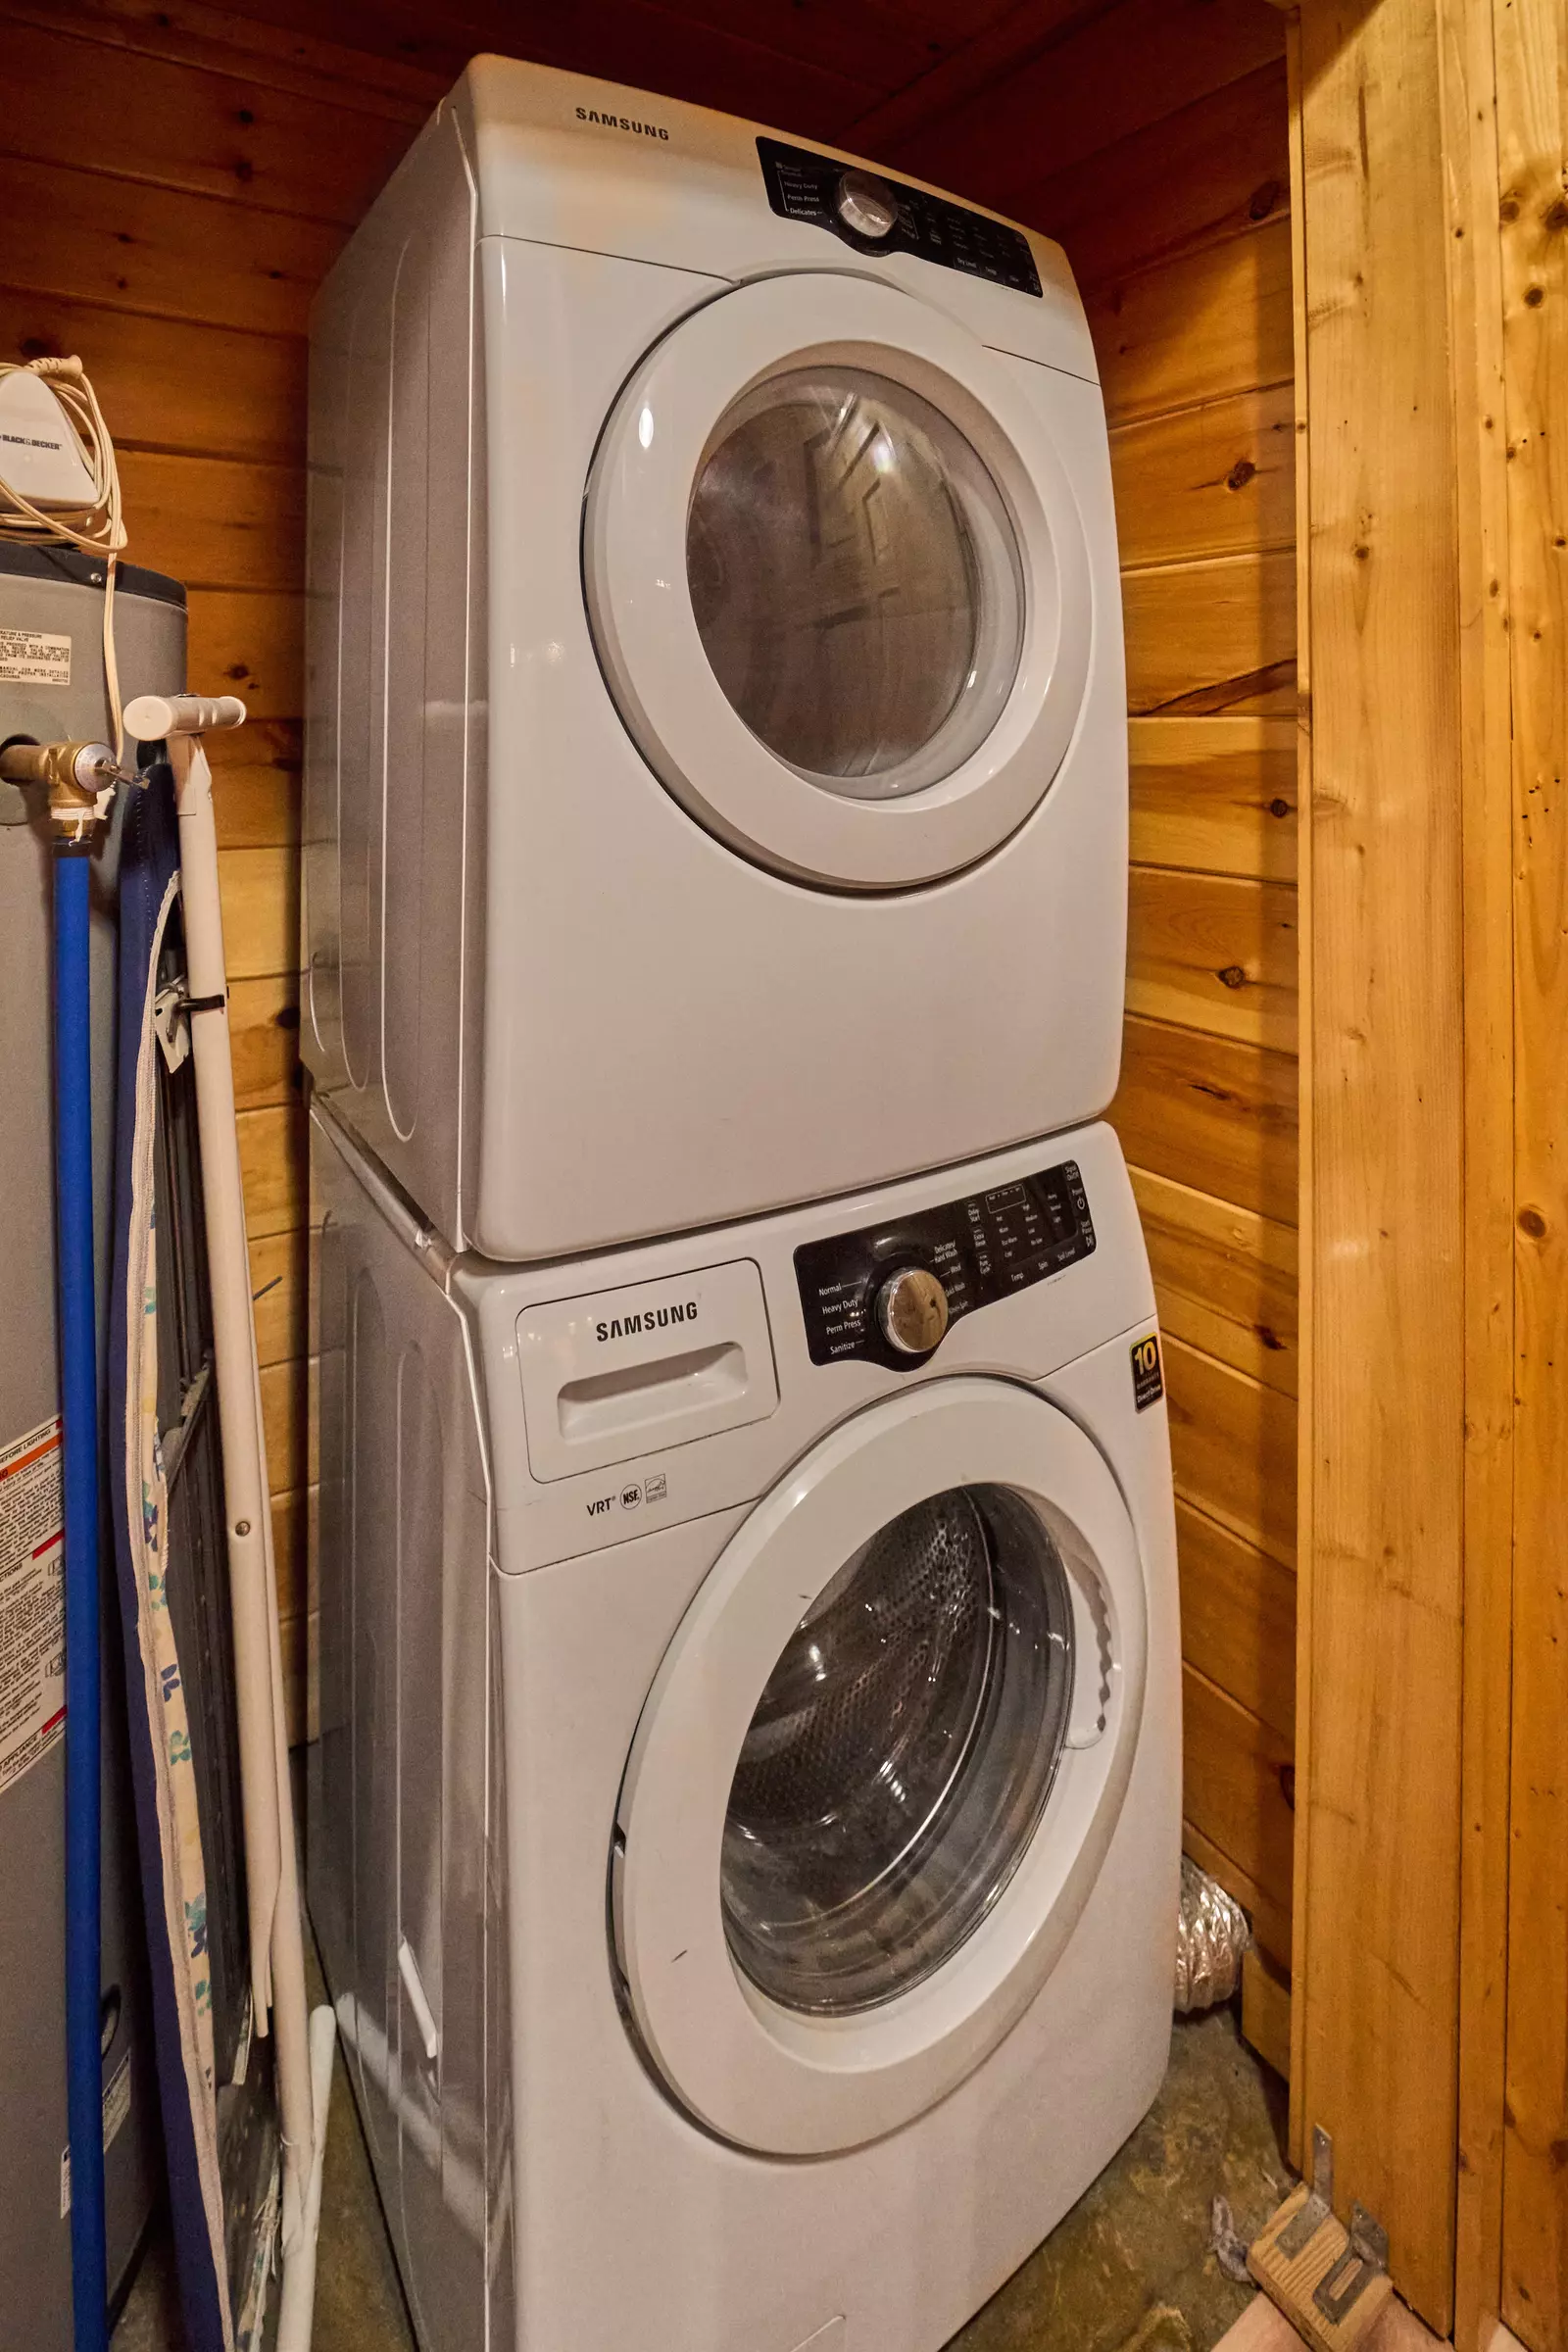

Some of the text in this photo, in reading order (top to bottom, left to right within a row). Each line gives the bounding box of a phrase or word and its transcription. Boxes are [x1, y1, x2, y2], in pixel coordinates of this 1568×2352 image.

[575, 107, 669, 141] SAMSUNG
[790, 207, 817, 217] Delicates
[1038, 1261, 1049, 1271] Spin
[1010, 1271, 1025, 1283] Temp
[818, 1282, 842, 1297] Normal
[822, 1298, 858, 1315] Heavy Duty
[596, 1301, 699, 1343] SAMSUNG
[825, 1319, 861, 1336] Perm Press
[829, 1342, 856, 1355] Sanitize
[1134, 1341, 1157, 1376] 10
[23, 1428, 51, 1450] LIGHTING
